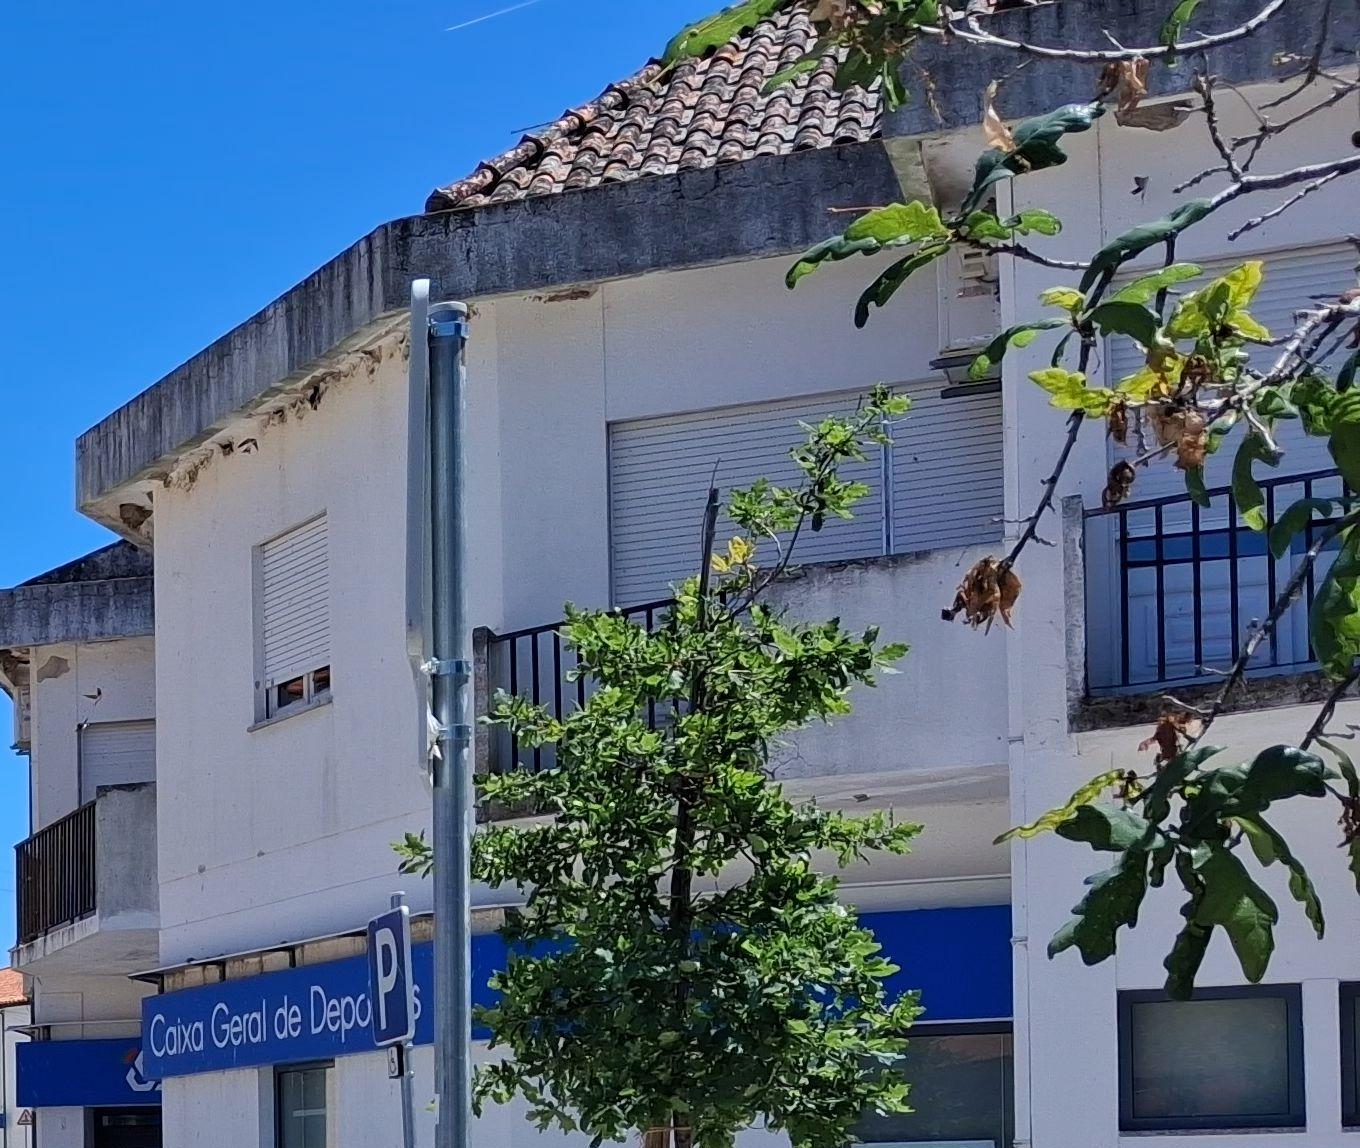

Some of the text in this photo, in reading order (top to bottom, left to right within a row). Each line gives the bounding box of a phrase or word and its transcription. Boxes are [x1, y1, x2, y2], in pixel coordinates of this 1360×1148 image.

[375, 927, 398, 1031] P
[149, 1013, 204, 1058] Caixa
[211, 999, 267, 1050] Geral
[274, 995, 302, 1040] de
